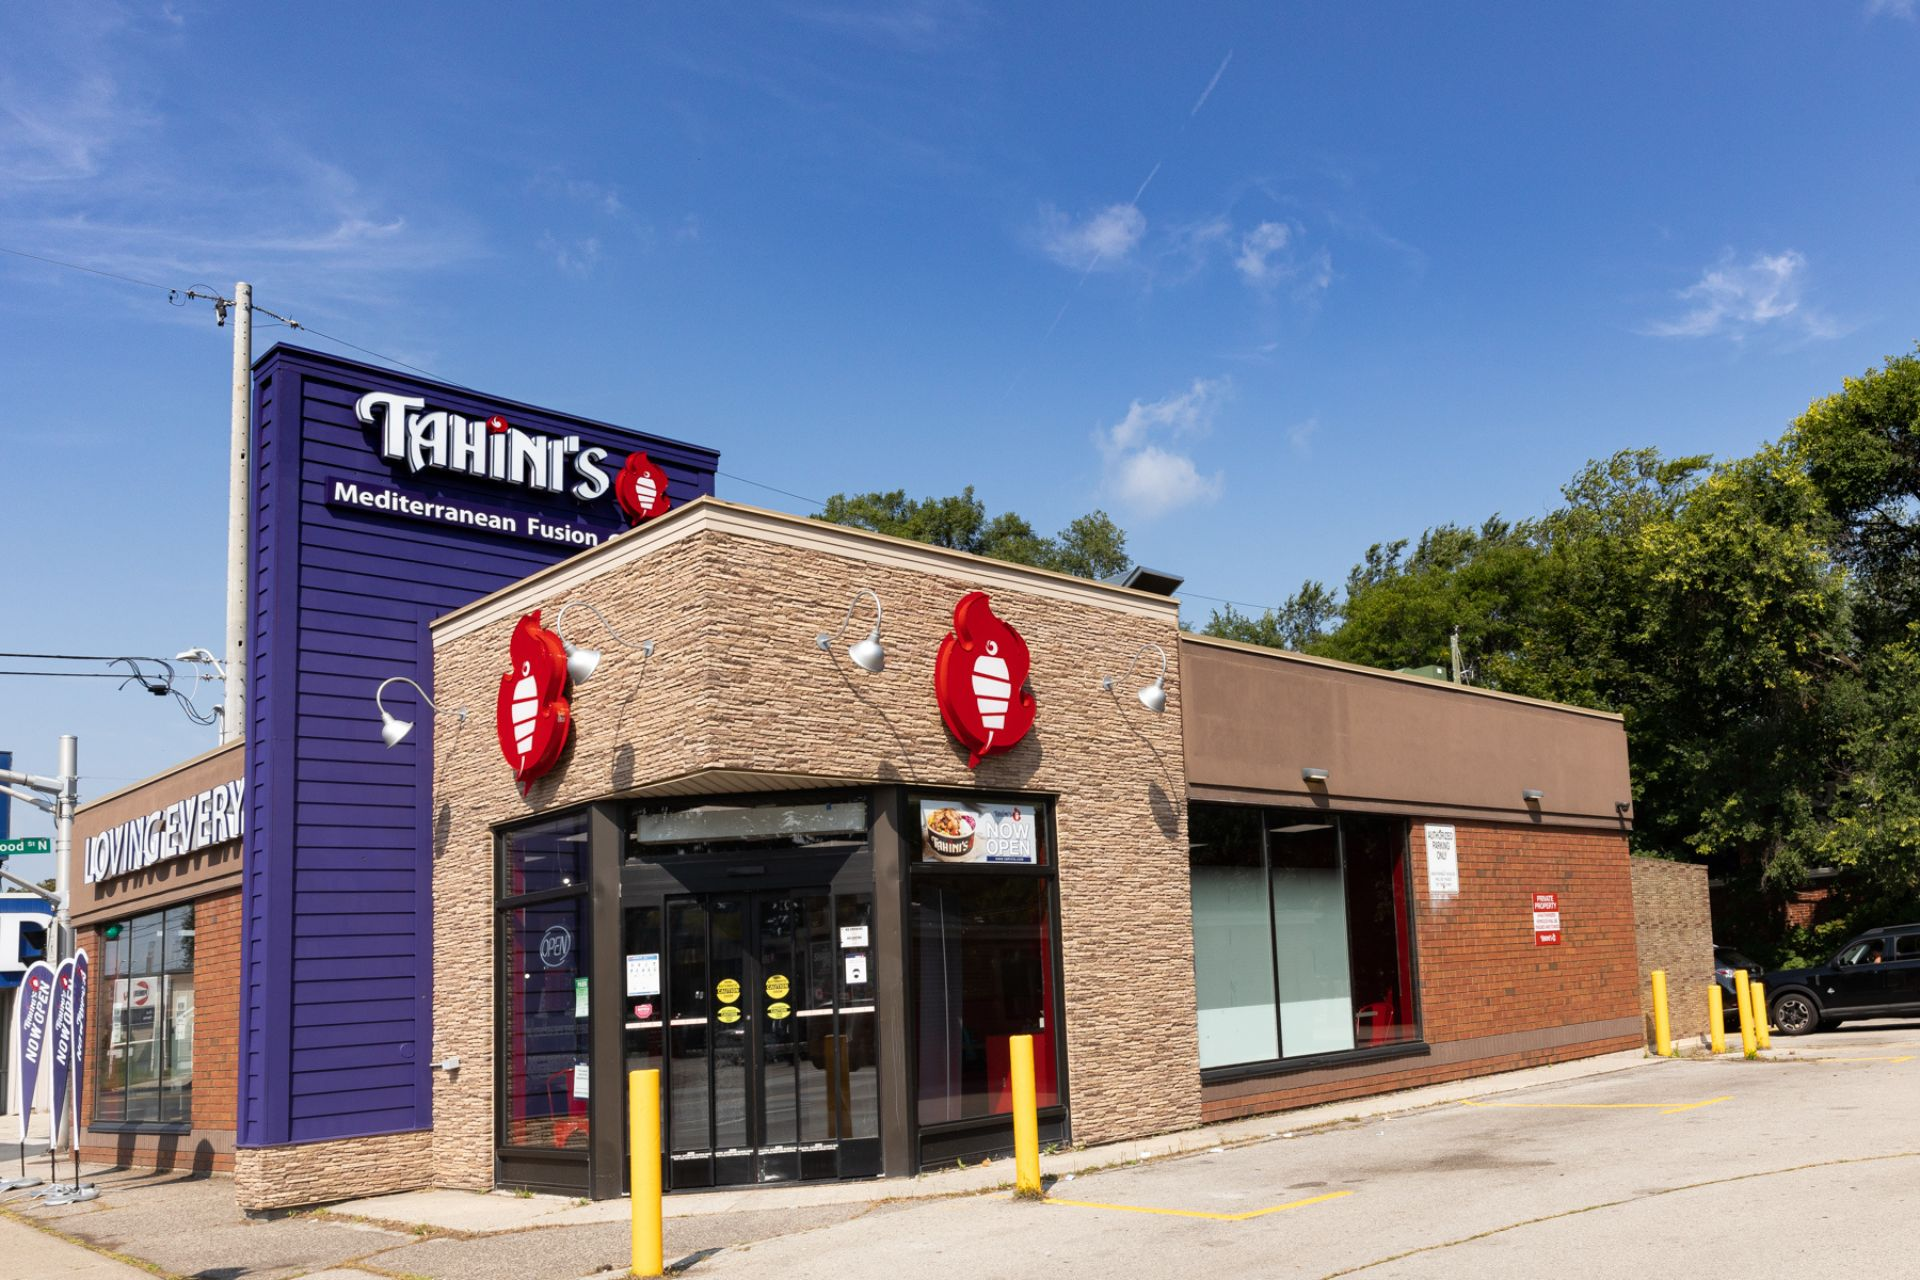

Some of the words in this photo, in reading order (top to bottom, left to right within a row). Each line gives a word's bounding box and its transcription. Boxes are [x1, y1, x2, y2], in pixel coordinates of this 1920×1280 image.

[334, 481, 516, 531] Mediterranean
[528, 517, 598, 546] Fusion
[38, 840, 47, 851] N
[84, 810, 163, 884] LOVING
[162, 777, 245, 859] EVERY
[986, 822, 1029, 839] NOW
[986, 839, 1030, 855] OPEN
[541, 935, 568, 958] OPEN
[25, 1022, 42, 1063] NOW
[34, 980, 50, 1025] OPEN
[56, 1023, 71, 1066] NOW
